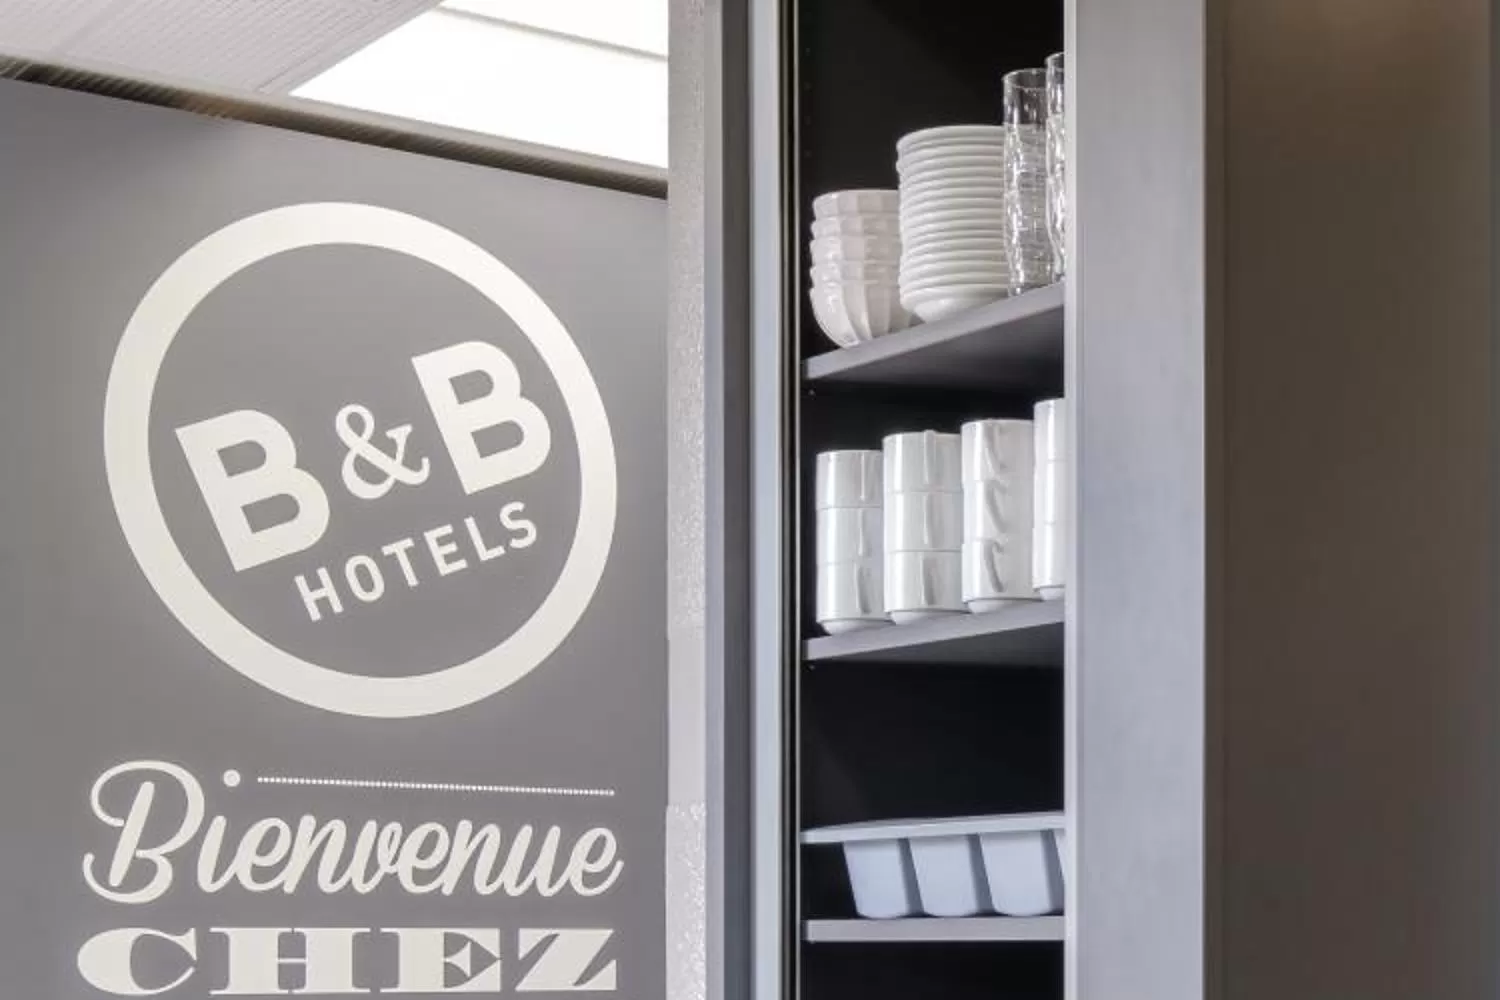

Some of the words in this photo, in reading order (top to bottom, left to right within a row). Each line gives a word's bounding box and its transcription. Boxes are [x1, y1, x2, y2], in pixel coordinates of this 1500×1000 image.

[175, 340, 551, 572] B&B
[295, 501, 537, 621] HOTELS
[83, 760, 624, 903] Bienvenue
[77, 927, 618, 995] CHEZ
